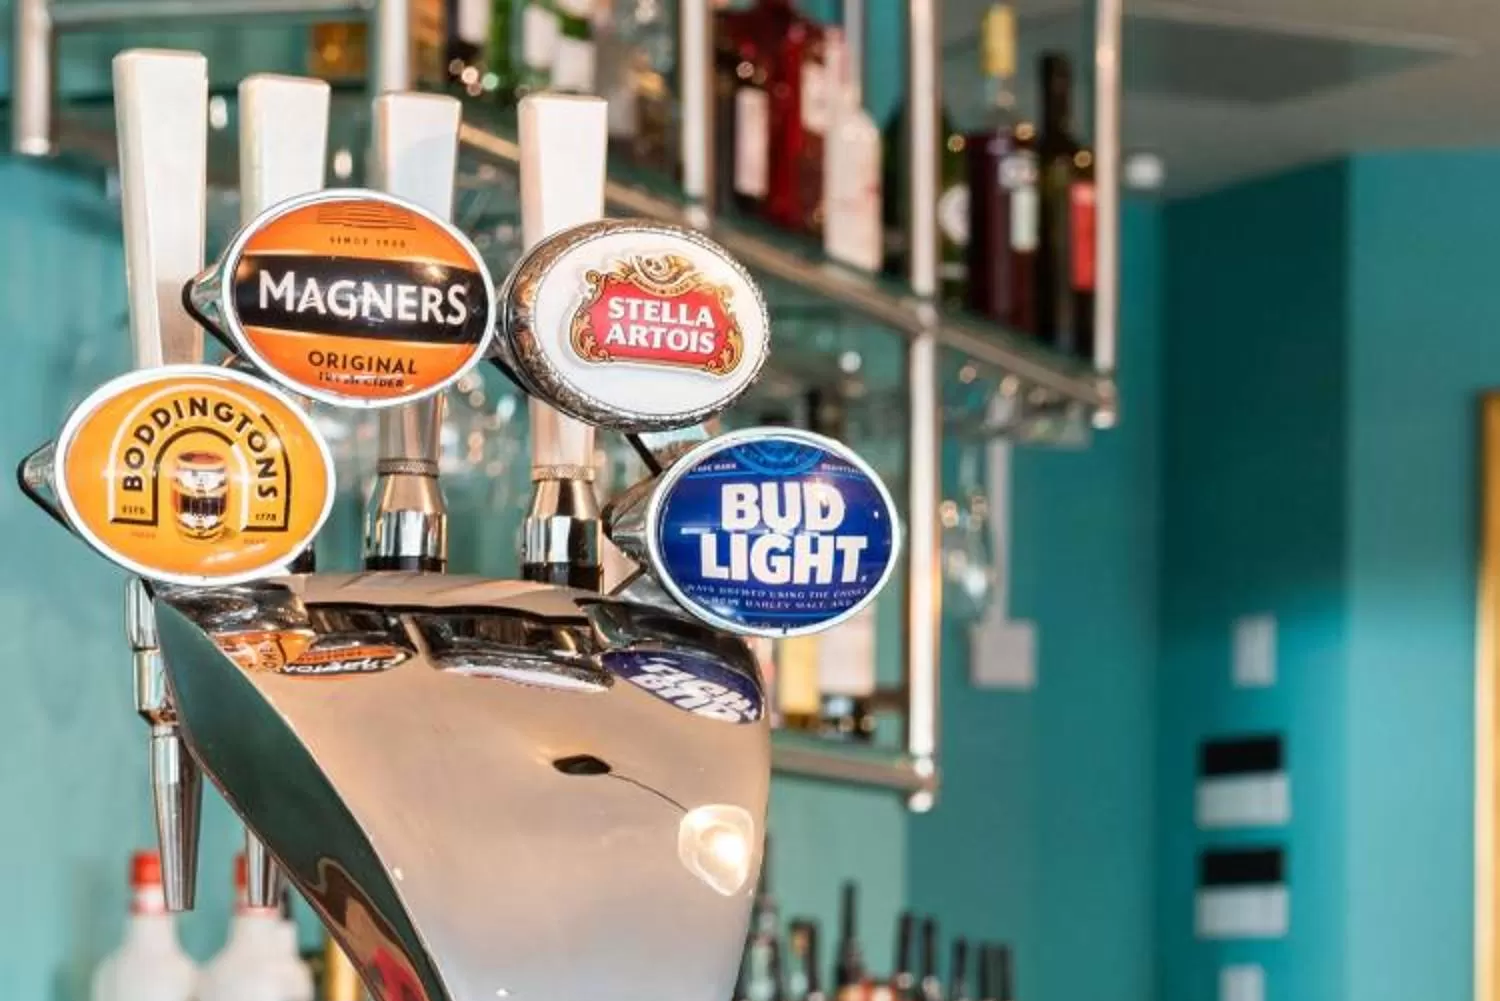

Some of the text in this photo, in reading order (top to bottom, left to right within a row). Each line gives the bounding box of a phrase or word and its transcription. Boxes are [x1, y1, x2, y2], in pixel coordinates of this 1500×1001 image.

[258, 269, 468, 326] MAGNERS
[607, 296, 715, 328] STELLA
[307, 350, 417, 375] ORIGINAL
[605, 323, 715, 354] ARTOIS
[122, 396, 278, 500] BODDINGTONS
[721, 481, 846, 533] BUD
[700, 532, 868, 585] LIGHT
